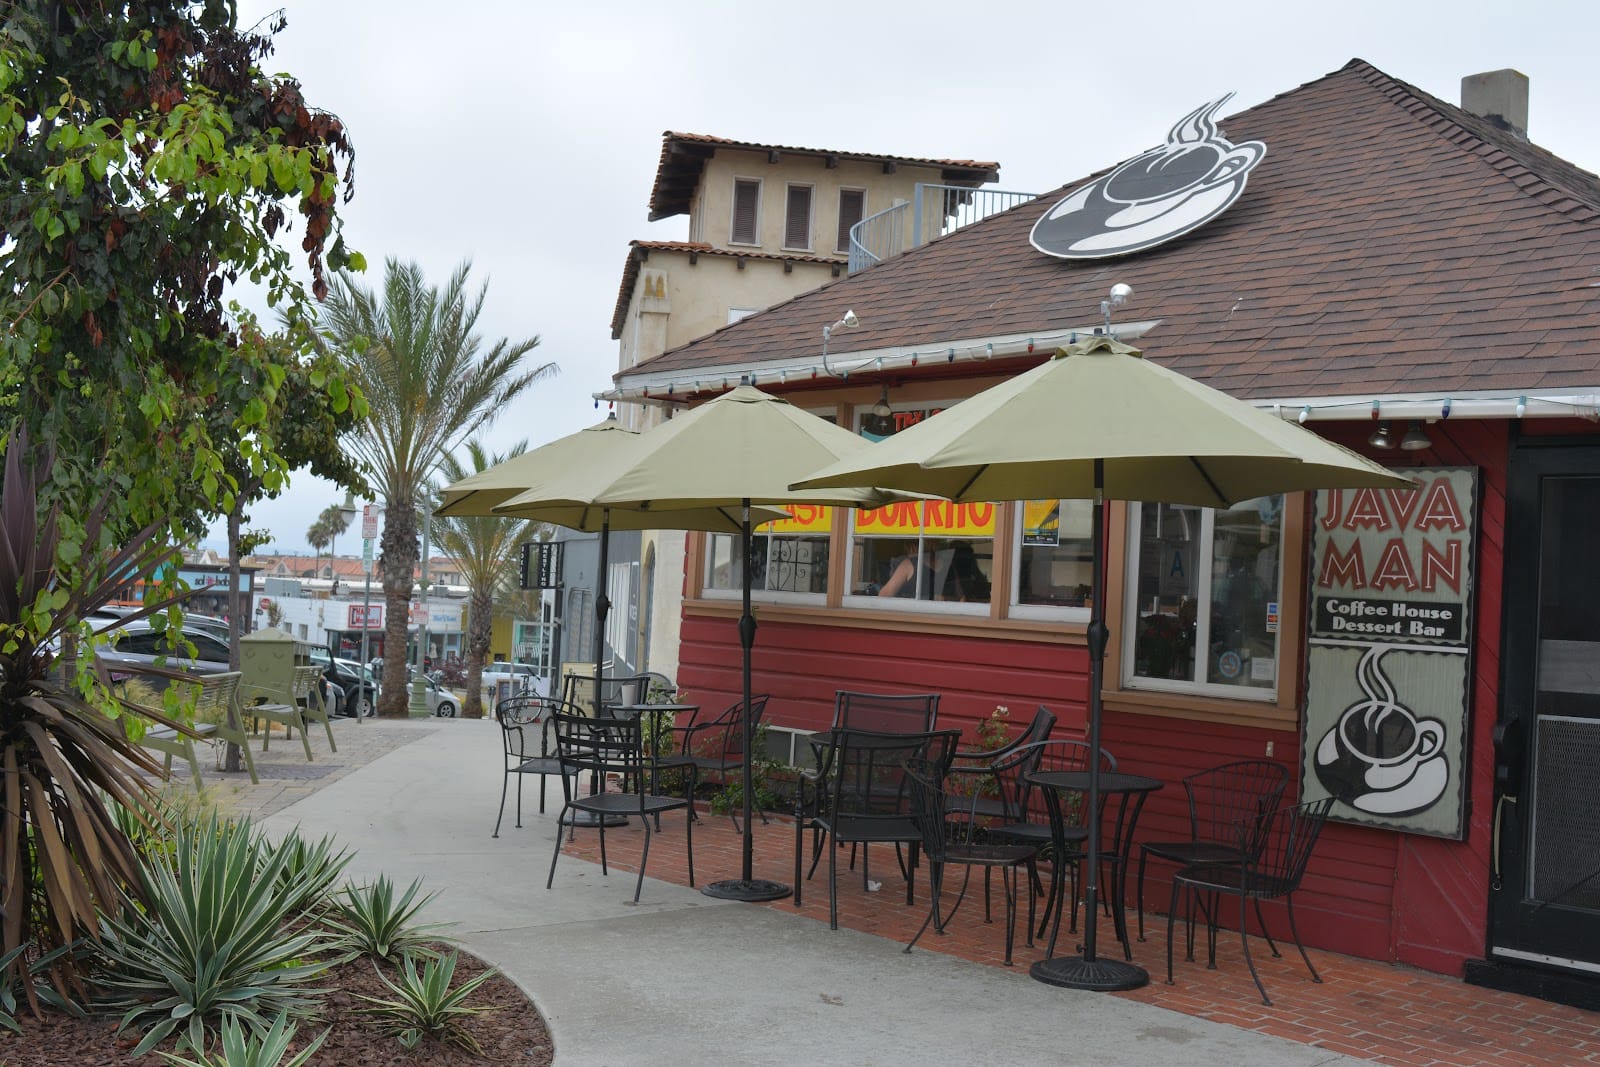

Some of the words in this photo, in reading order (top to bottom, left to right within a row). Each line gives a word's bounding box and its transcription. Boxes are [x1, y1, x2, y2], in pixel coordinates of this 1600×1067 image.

[1320, 477, 1466, 533] JAVA
[1170, 550, 1184, 577] A
[1318, 536, 1462, 595] MAN
[1326, 599, 1388, 616] Coffee
[1392, 603, 1453, 619] House
[1332, 616, 1402, 634] Dessert
[1409, 621, 1445, 637] Bar
